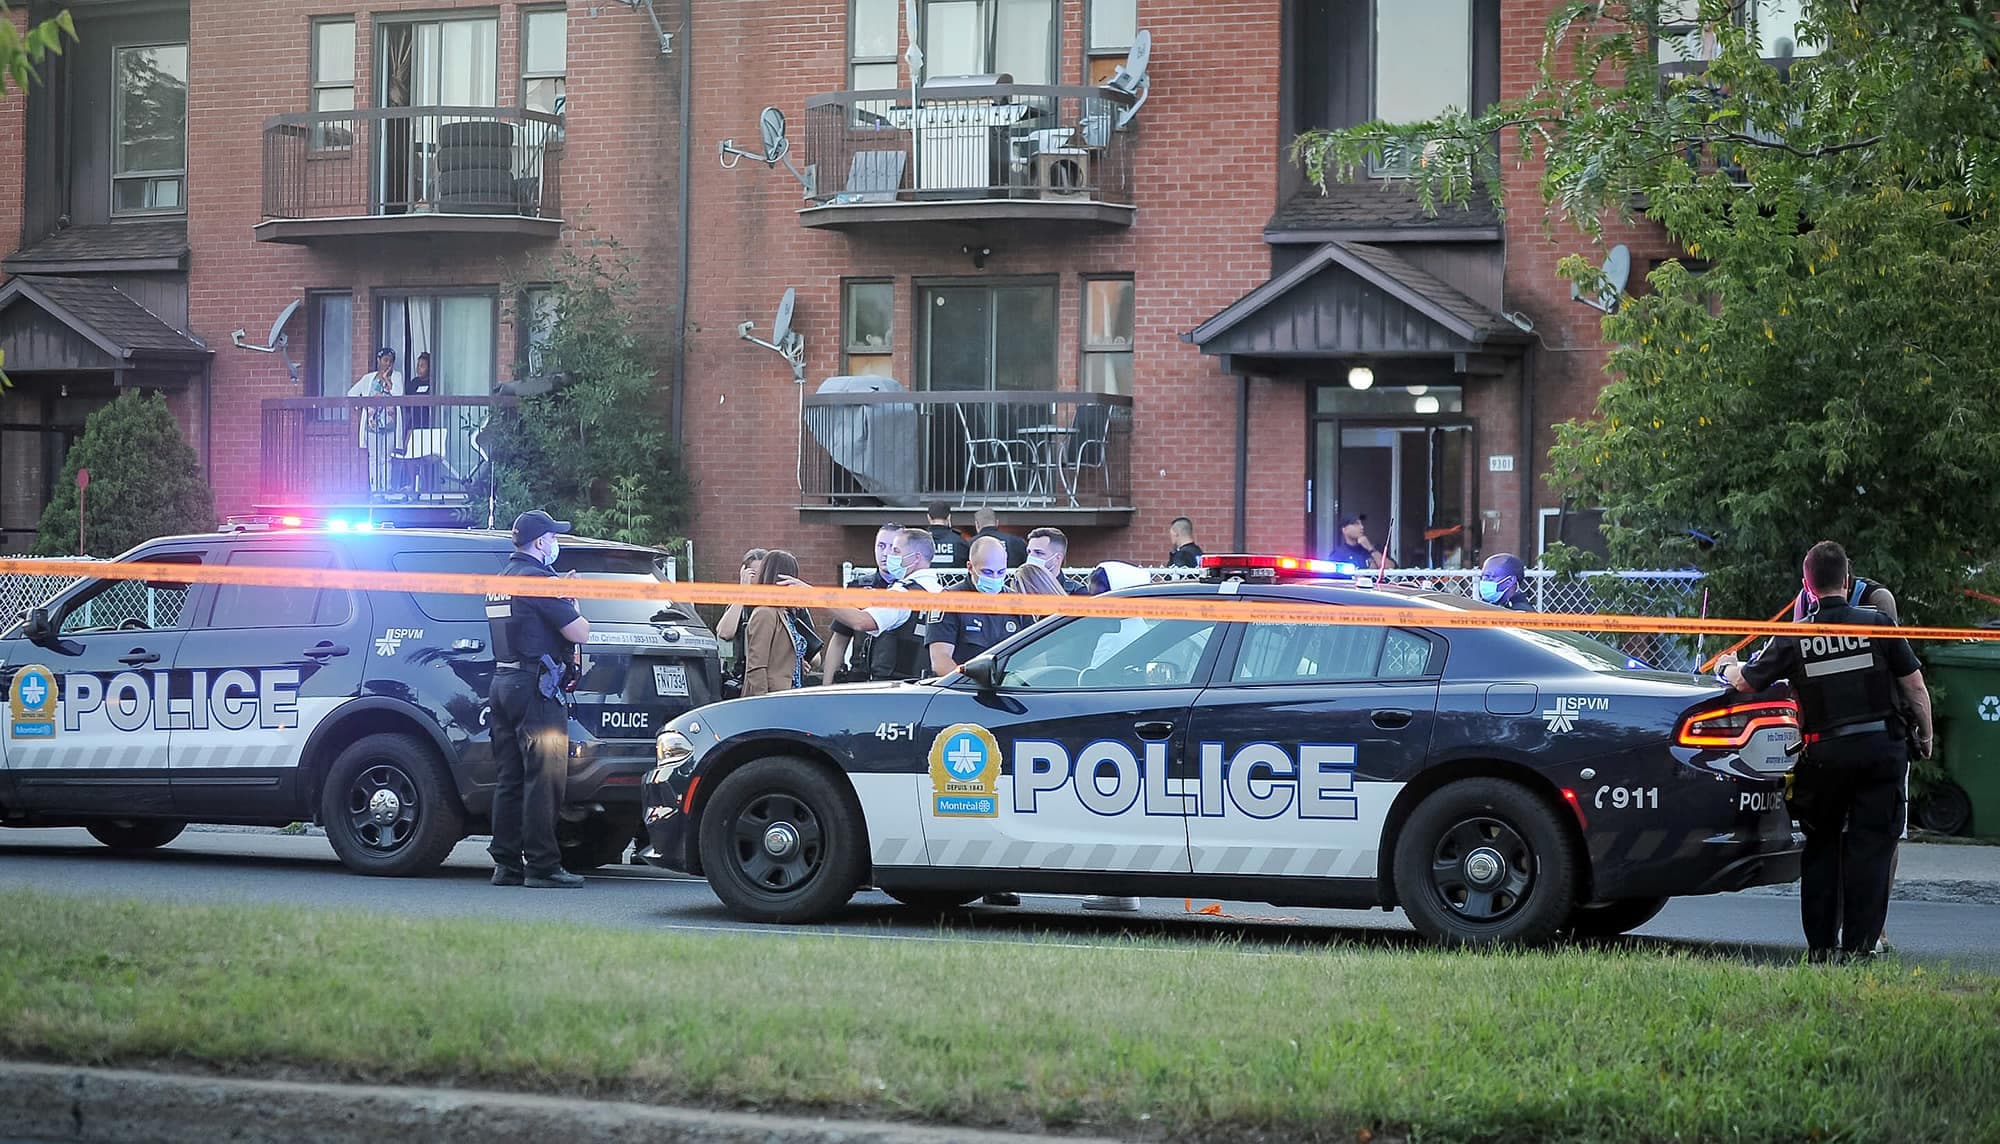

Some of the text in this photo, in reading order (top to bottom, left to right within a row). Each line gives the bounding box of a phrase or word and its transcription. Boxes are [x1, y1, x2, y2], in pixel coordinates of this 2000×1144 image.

[393, 628, 425, 639] SPVM
[1800, 635, 1871, 659] POLICE
[64, 668, 300, 732] POLICE
[1567, 697, 1609, 711] SPVM
[601, 711, 649, 728] POLICE
[875, 721, 914, 741] 45-1
[1012, 738, 1358, 820] POLICE
[940, 800, 978, 811] Montréal
[1612, 786, 1658, 809] 911
[1739, 791, 1783, 812] POLICE
